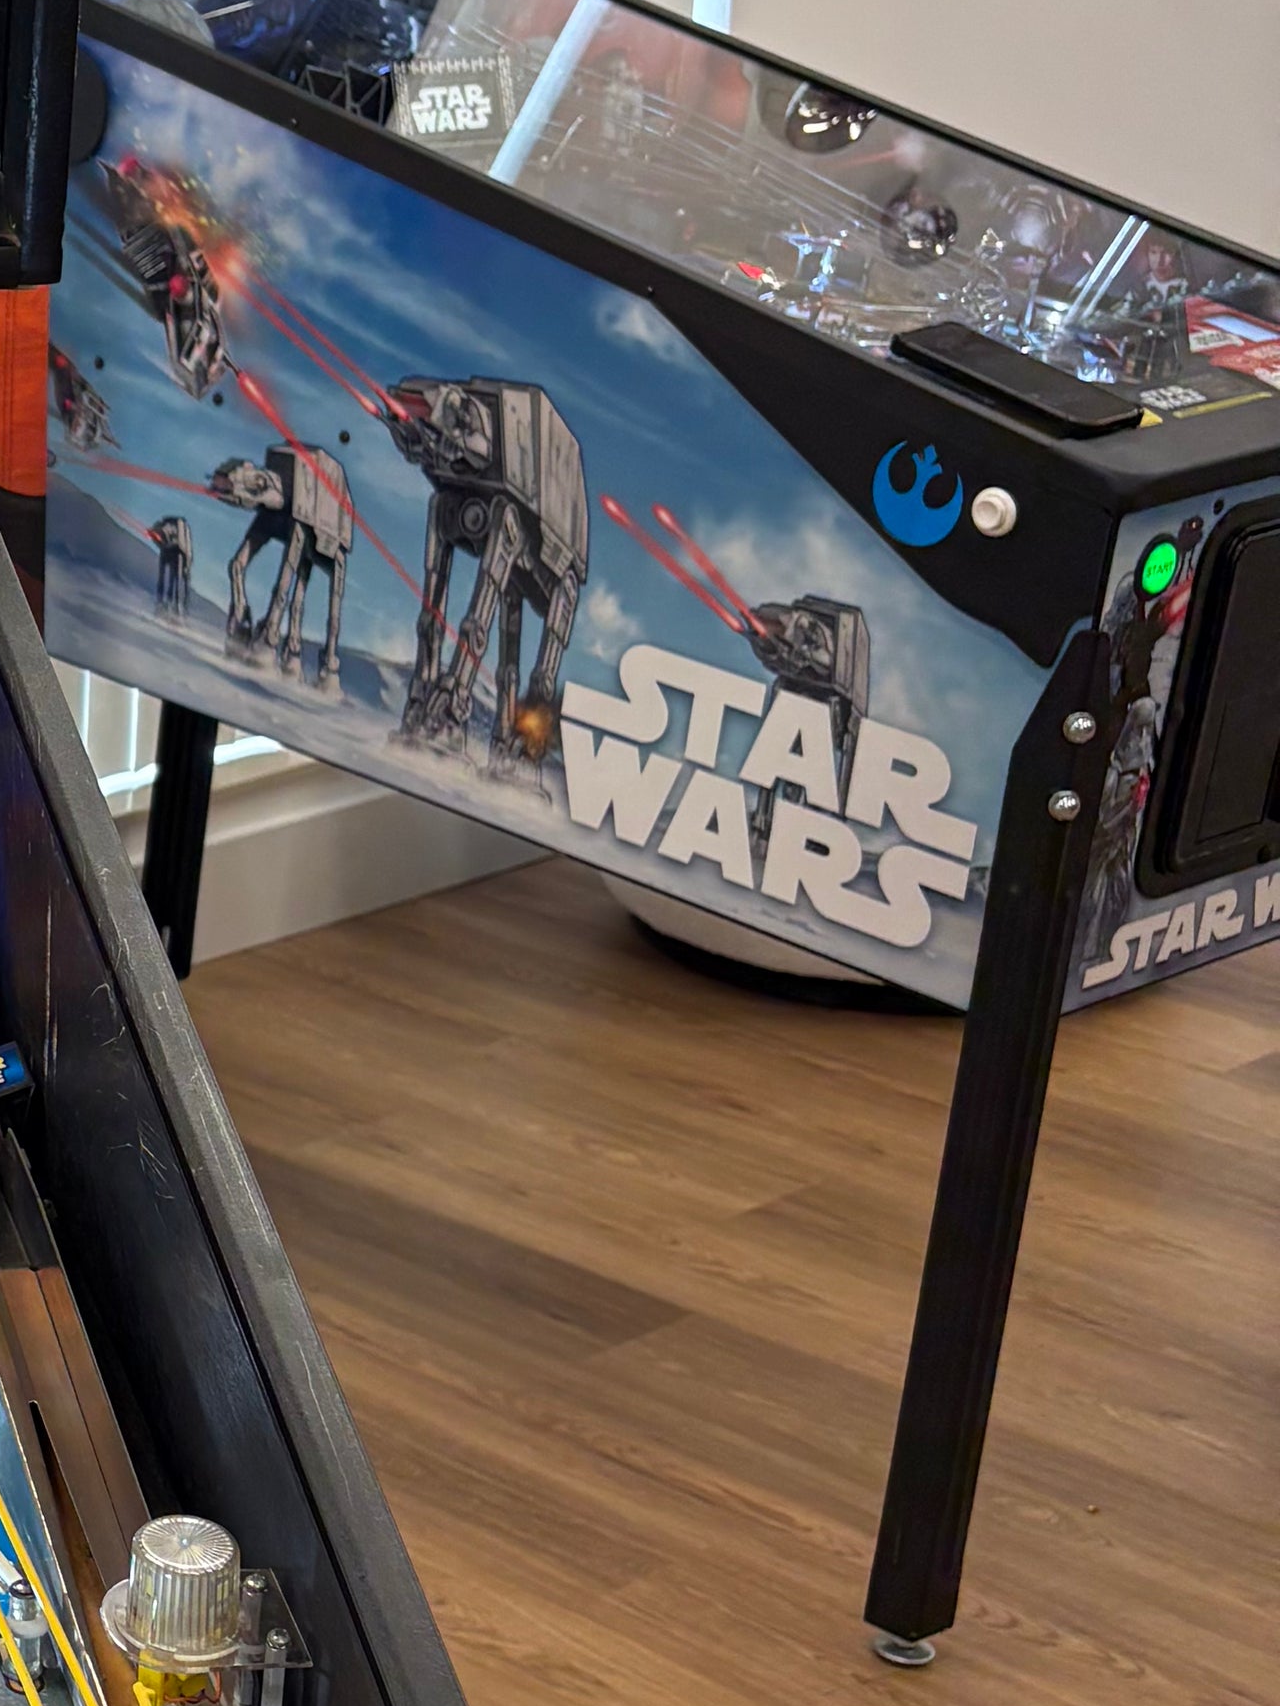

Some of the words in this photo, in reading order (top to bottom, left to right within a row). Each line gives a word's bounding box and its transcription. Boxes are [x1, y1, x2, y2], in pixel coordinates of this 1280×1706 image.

[411, 84, 491, 111] STAR
[412, 105, 492, 134] WARS
[1145, 559, 1175, 579] START
[561, 645, 978, 864] STAR
[562, 718, 969, 948] WARS
[1082, 889, 1245, 990] STAR
